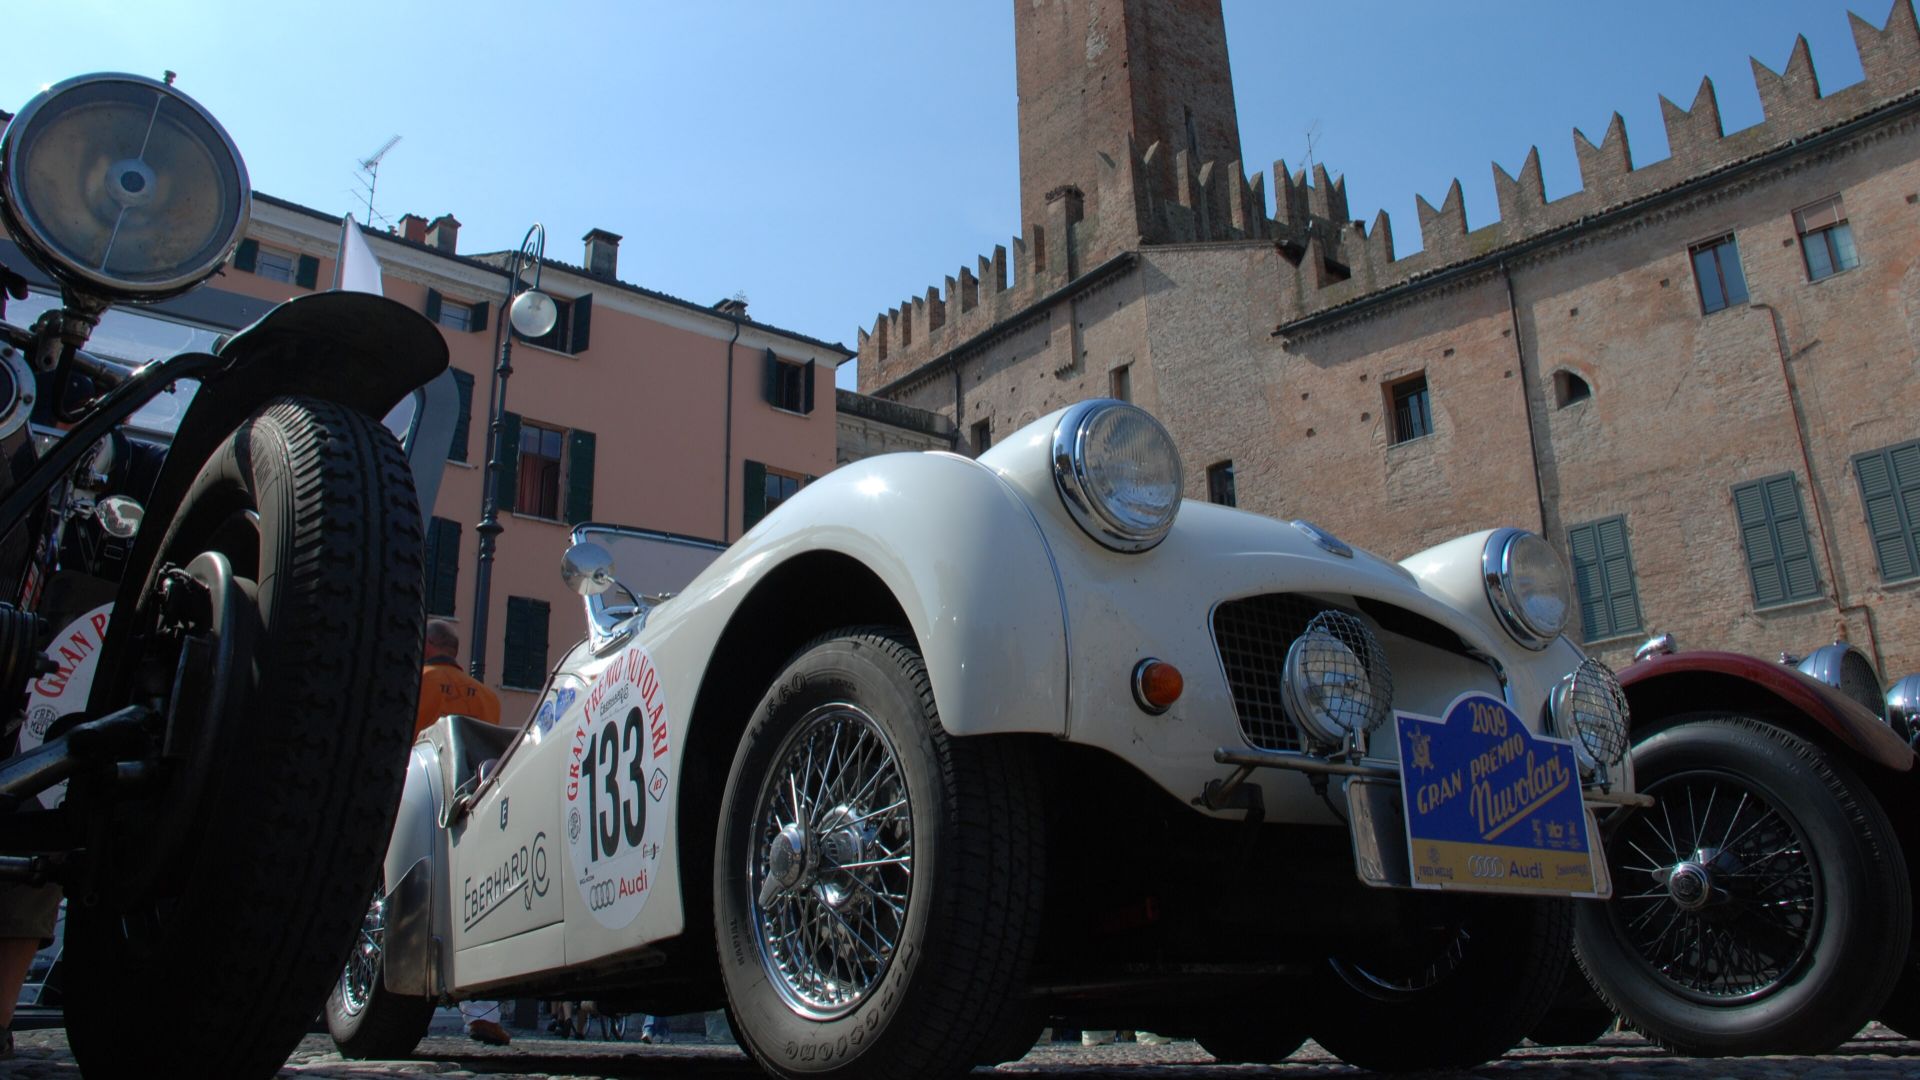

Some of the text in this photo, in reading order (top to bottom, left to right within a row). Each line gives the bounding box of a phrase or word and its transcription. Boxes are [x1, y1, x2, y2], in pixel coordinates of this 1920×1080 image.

[567, 726, 586, 801] GRAN
[584, 656, 624, 726] PREMIO
[624, 648, 669, 760] NUVOLARI
[1468, 701, 1508, 738] 2009
[582, 706, 646, 863] 133
[1416, 733, 1524, 815] GRAN PREMIO
[619, 868, 648, 899] Audi
[1508, 860, 1544, 880] Audi
